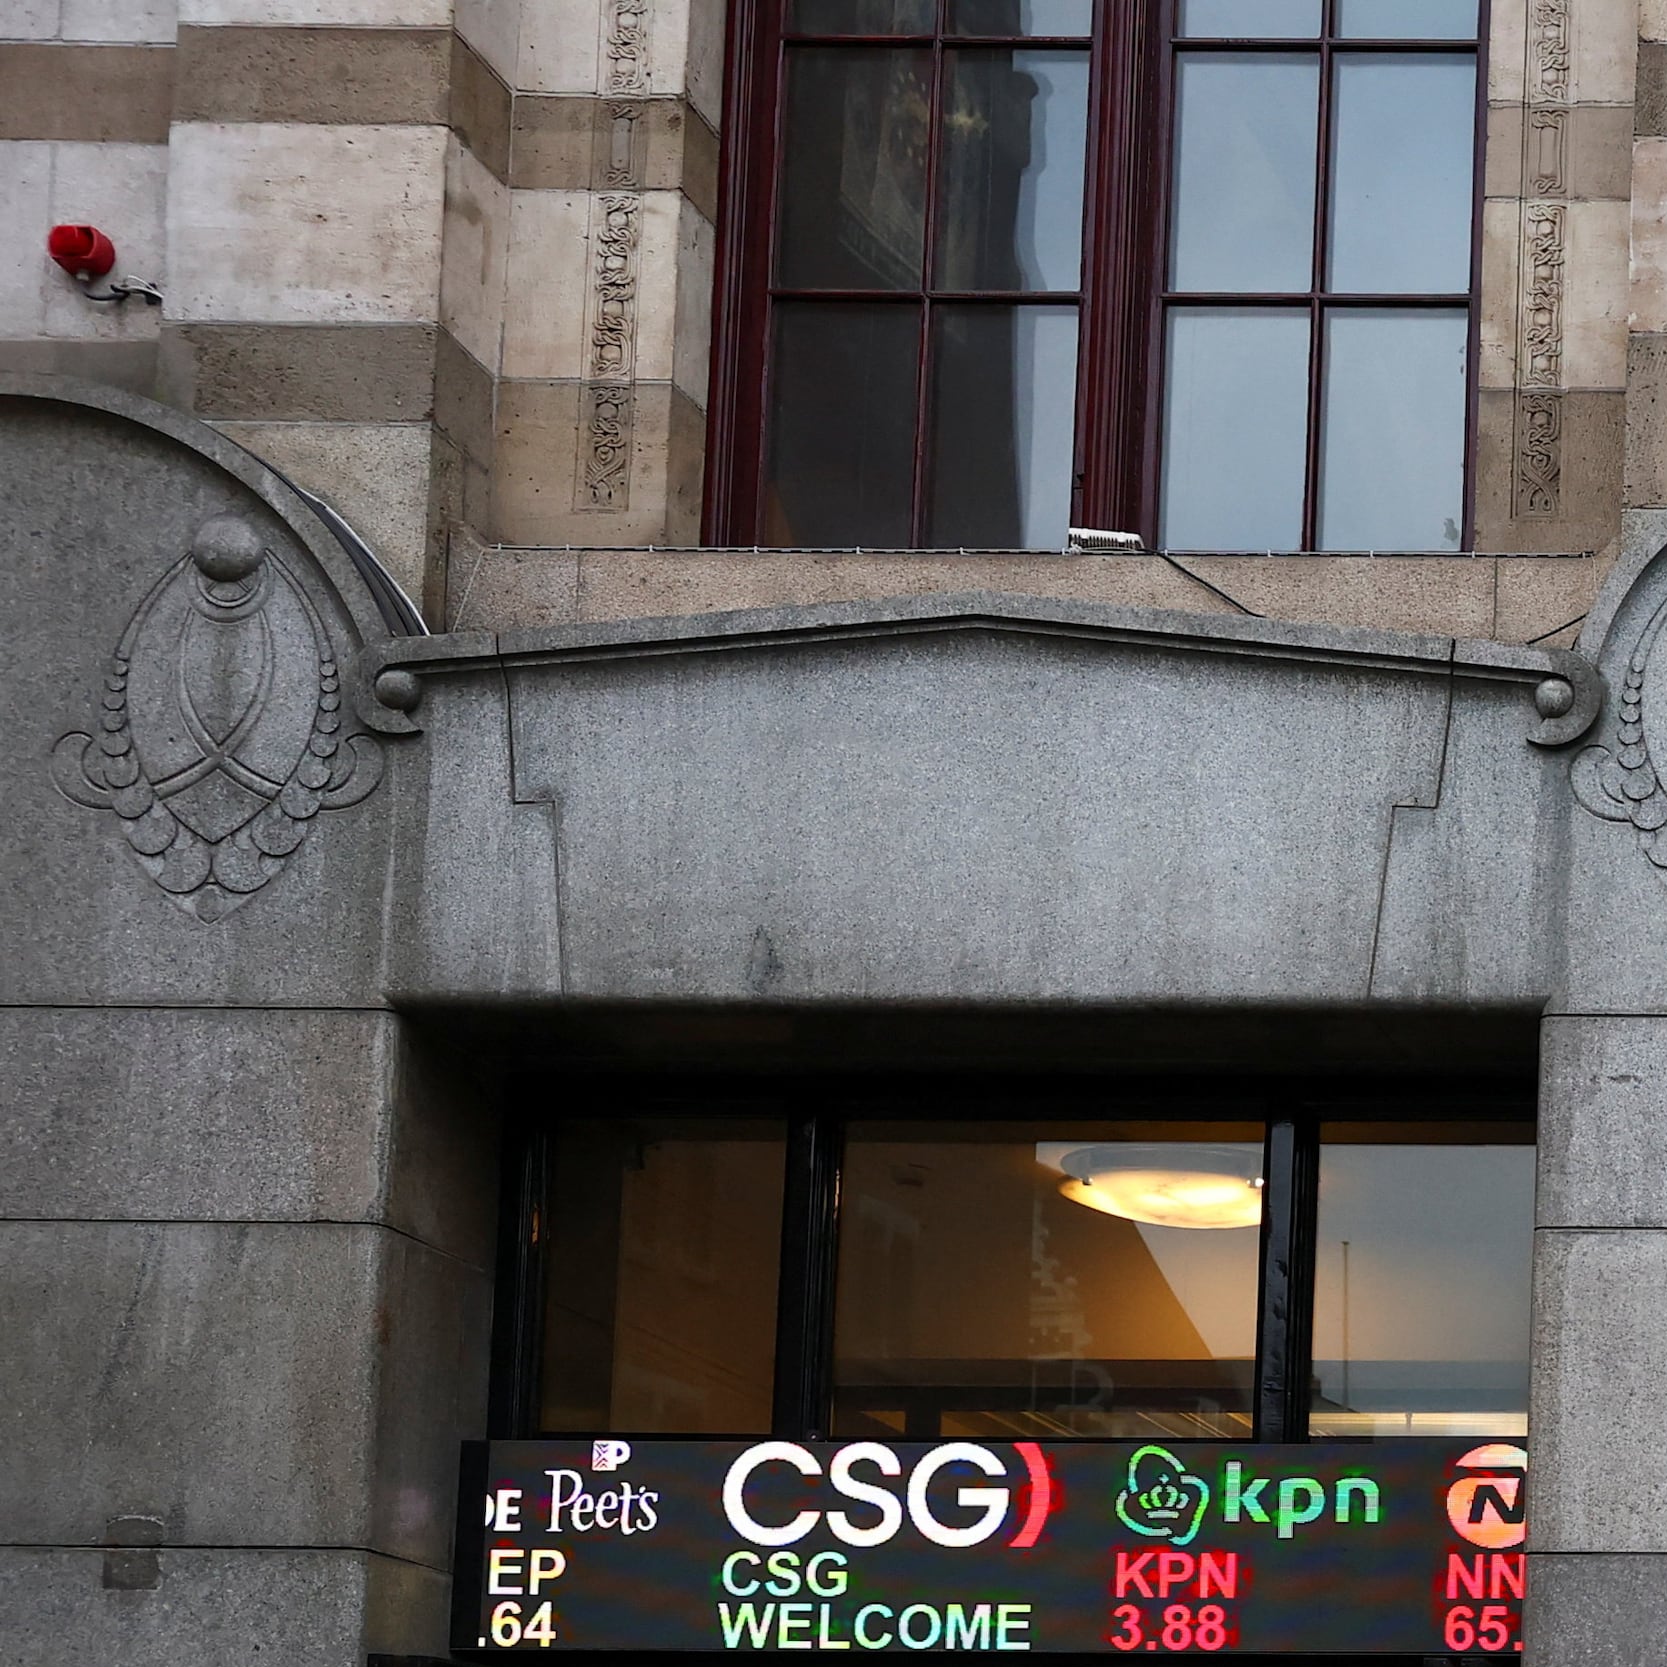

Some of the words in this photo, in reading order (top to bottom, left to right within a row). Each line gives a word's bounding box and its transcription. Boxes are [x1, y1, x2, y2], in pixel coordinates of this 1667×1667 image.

[1223, 1461, 1380, 1539] kpn
[488, 1549, 566, 1595] EP
[722, 1551, 848, 1597] CSG
[1115, 1552, 1239, 1599] KPN
[1446, 1553, 1526, 1599] NN
[717, 1603, 1032, 1650] WELCOME
[1110, 1604, 1226, 1652] 3.88
